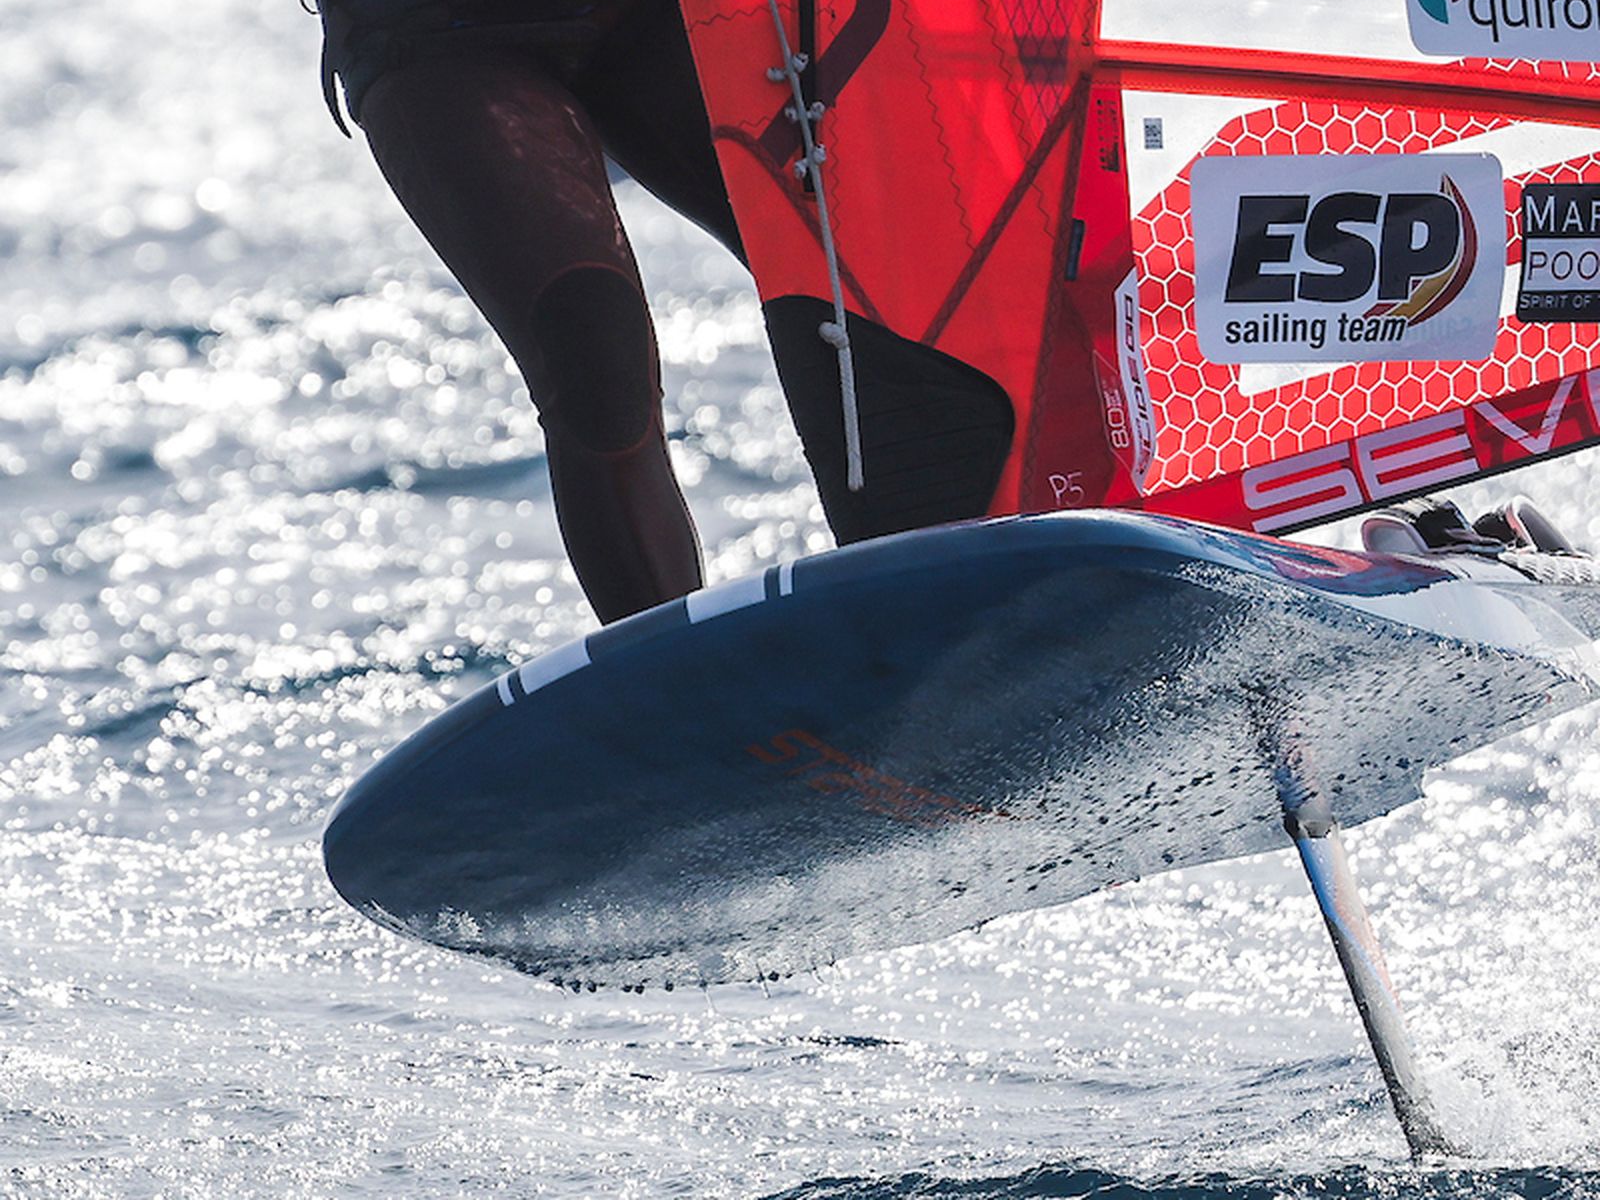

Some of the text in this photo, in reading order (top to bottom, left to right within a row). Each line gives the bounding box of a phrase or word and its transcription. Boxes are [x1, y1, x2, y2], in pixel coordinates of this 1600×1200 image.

[1224, 191, 1460, 303] ESP
[1519, 293, 1568, 309] SPIRIT
[1572, 294, 1591, 309] OF
[1225, 313, 1326, 349] sailing
[1338, 313, 1407, 342] team
[1241, 367, 1600, 533] SEV
[1048, 471, 1085, 506] P5
